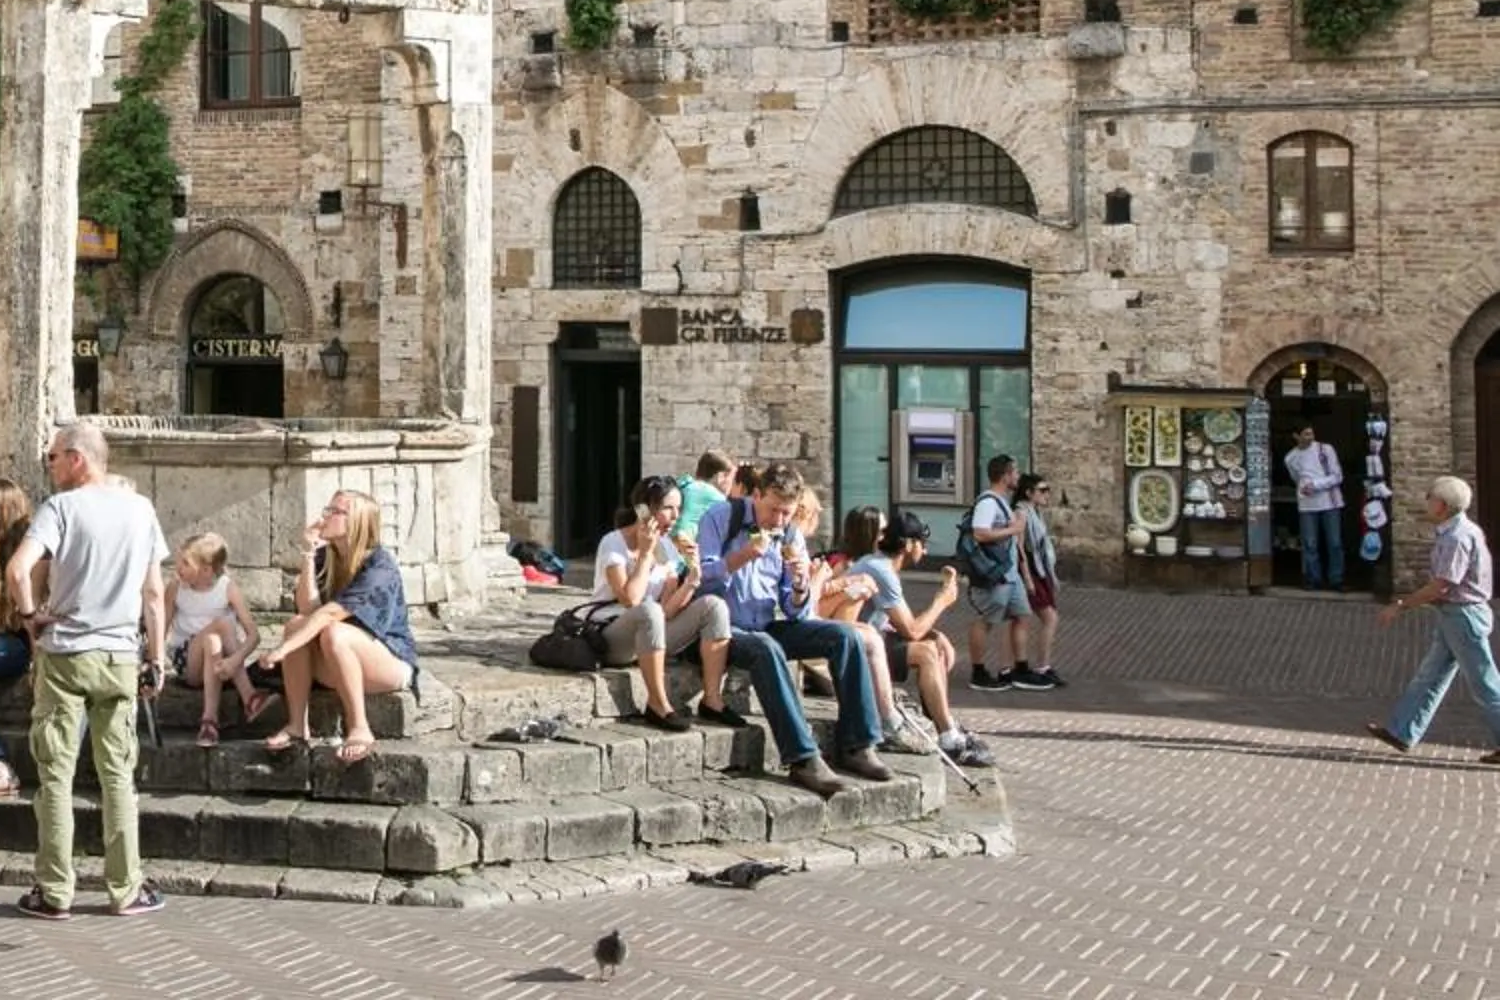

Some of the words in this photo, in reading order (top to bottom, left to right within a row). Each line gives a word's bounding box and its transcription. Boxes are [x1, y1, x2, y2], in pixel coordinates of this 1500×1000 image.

[681, 309, 744, 325] BANCA
[681, 327, 708, 343] CR
[713, 327, 787, 343] FIRENZE
[193, 338, 286, 357] CISTERNA
